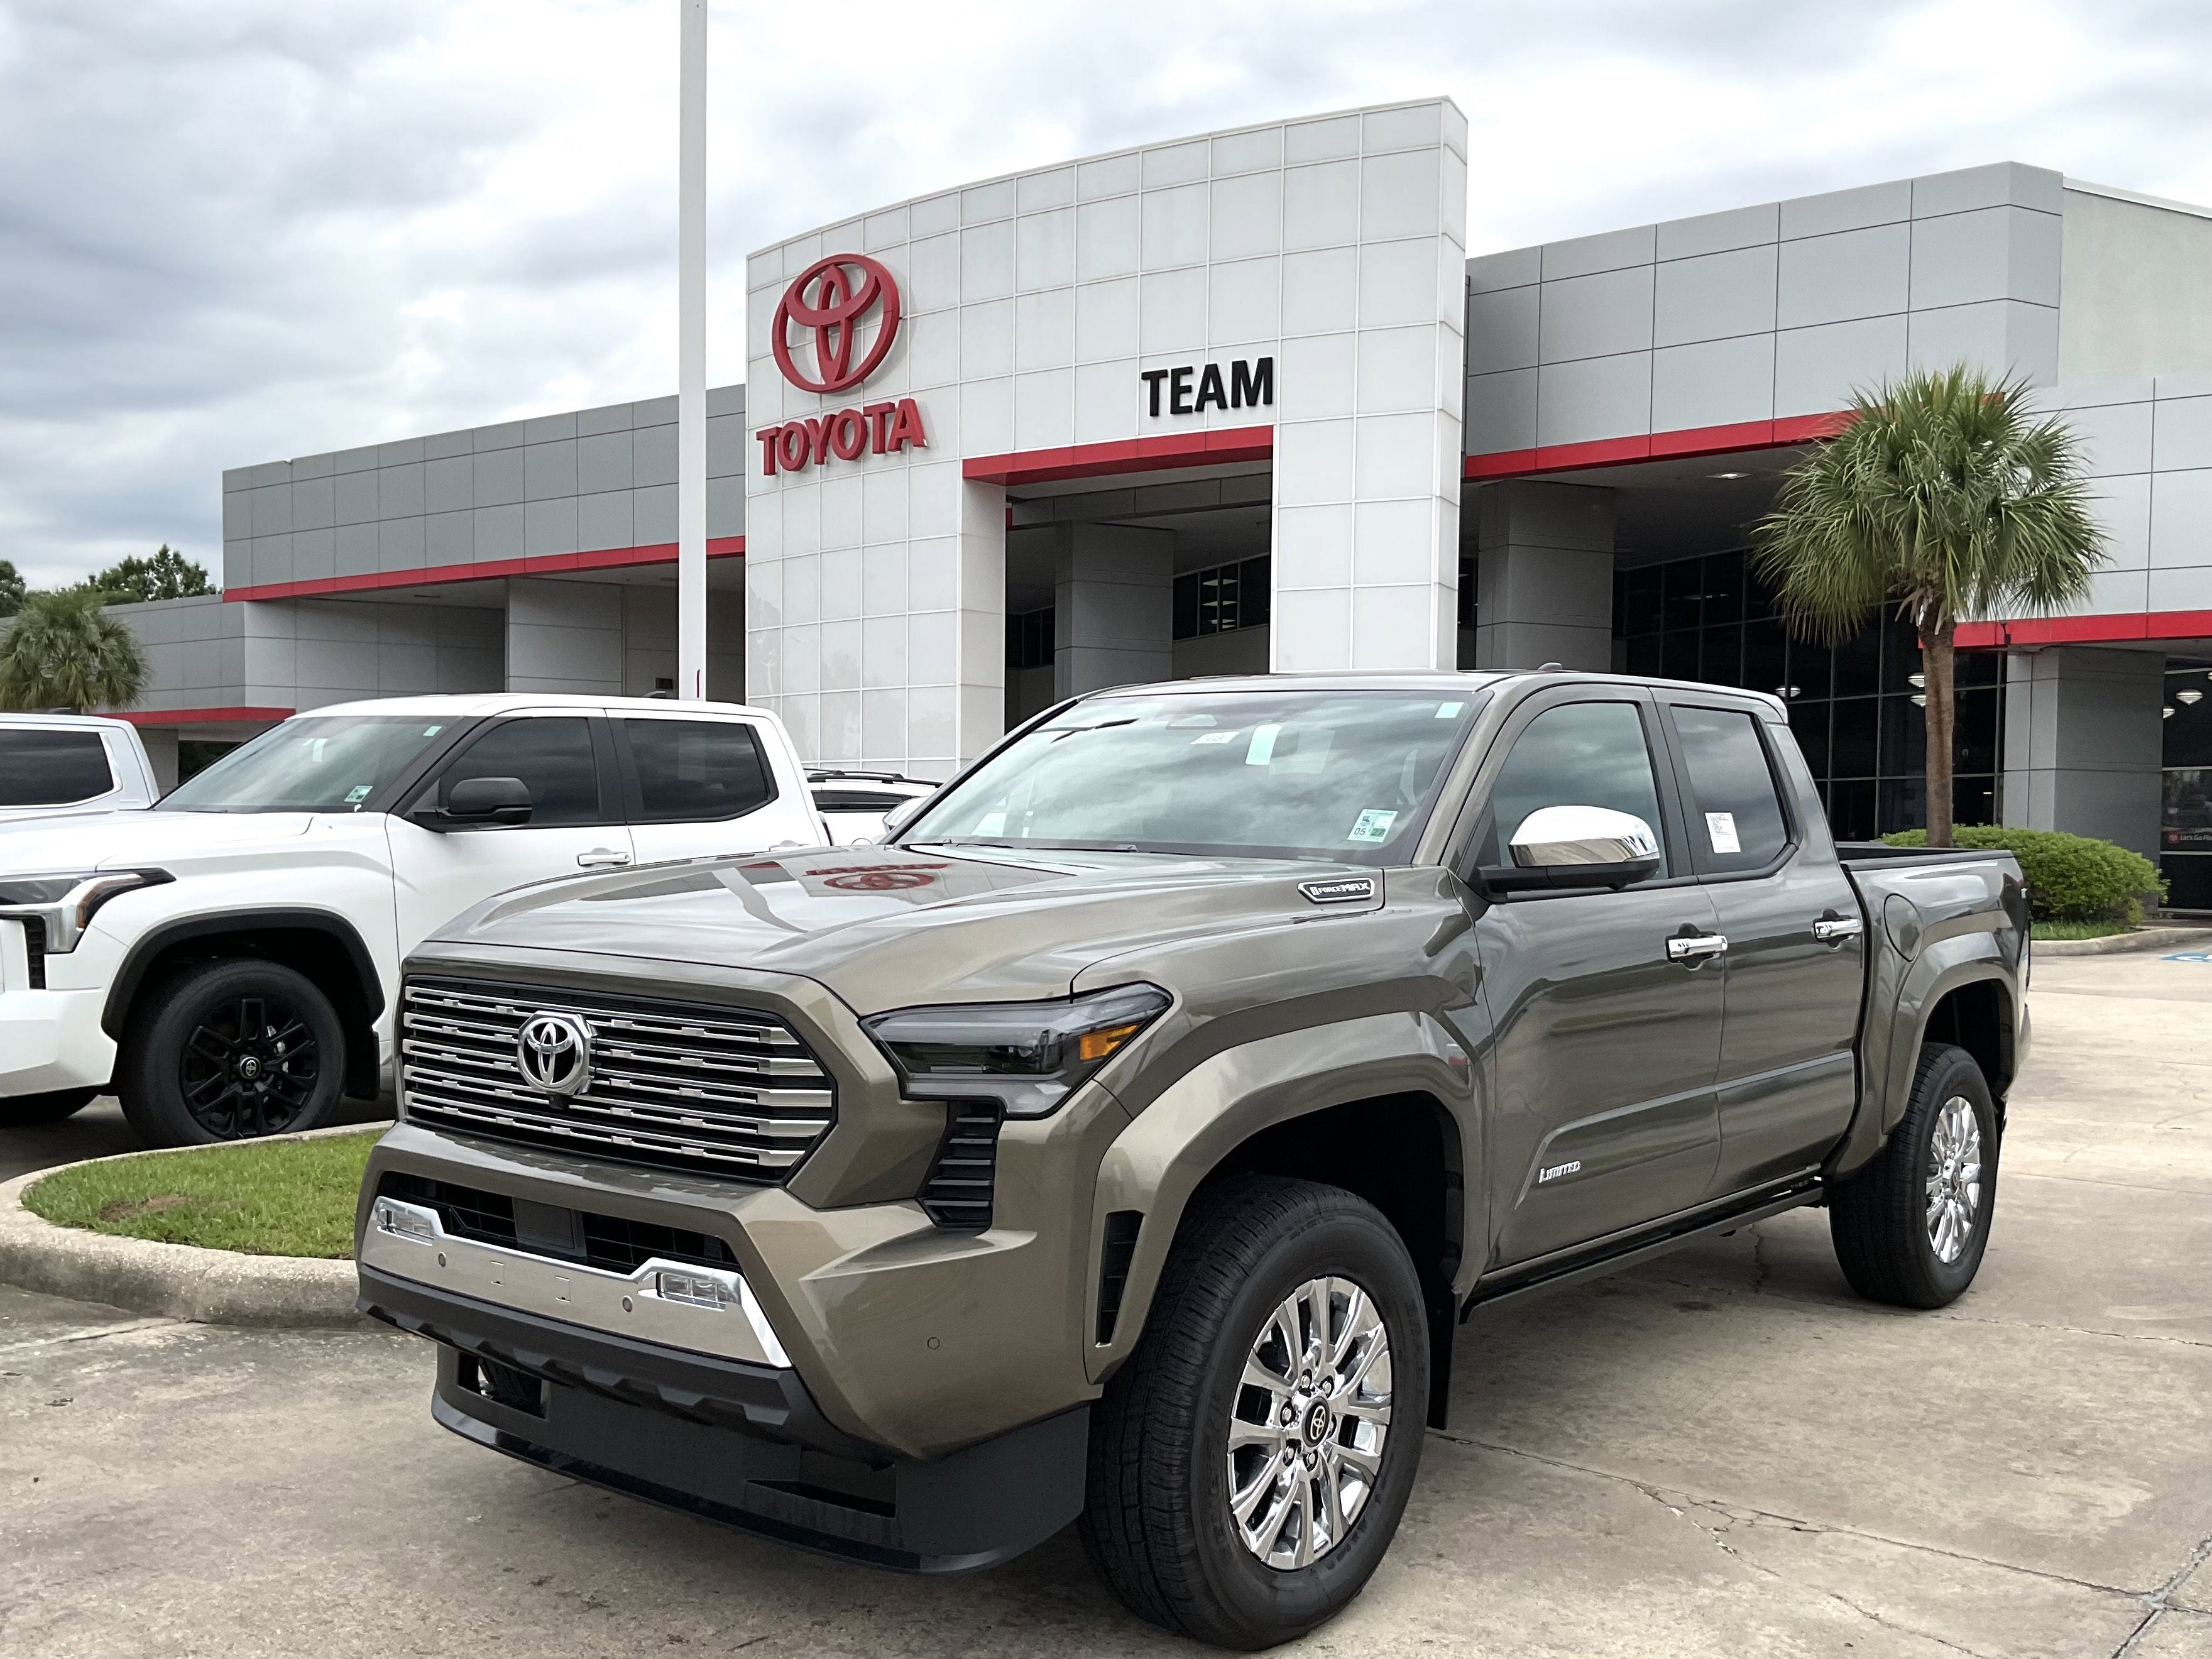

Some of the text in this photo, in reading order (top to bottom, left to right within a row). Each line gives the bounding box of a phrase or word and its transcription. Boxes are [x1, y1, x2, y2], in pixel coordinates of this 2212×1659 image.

[1141, 356, 1273, 417] TEAM
[756, 398, 927, 476] TOYOTA
[1354, 828, 1367, 836] 05
[1539, 1161, 1580, 1183] LIMITED
